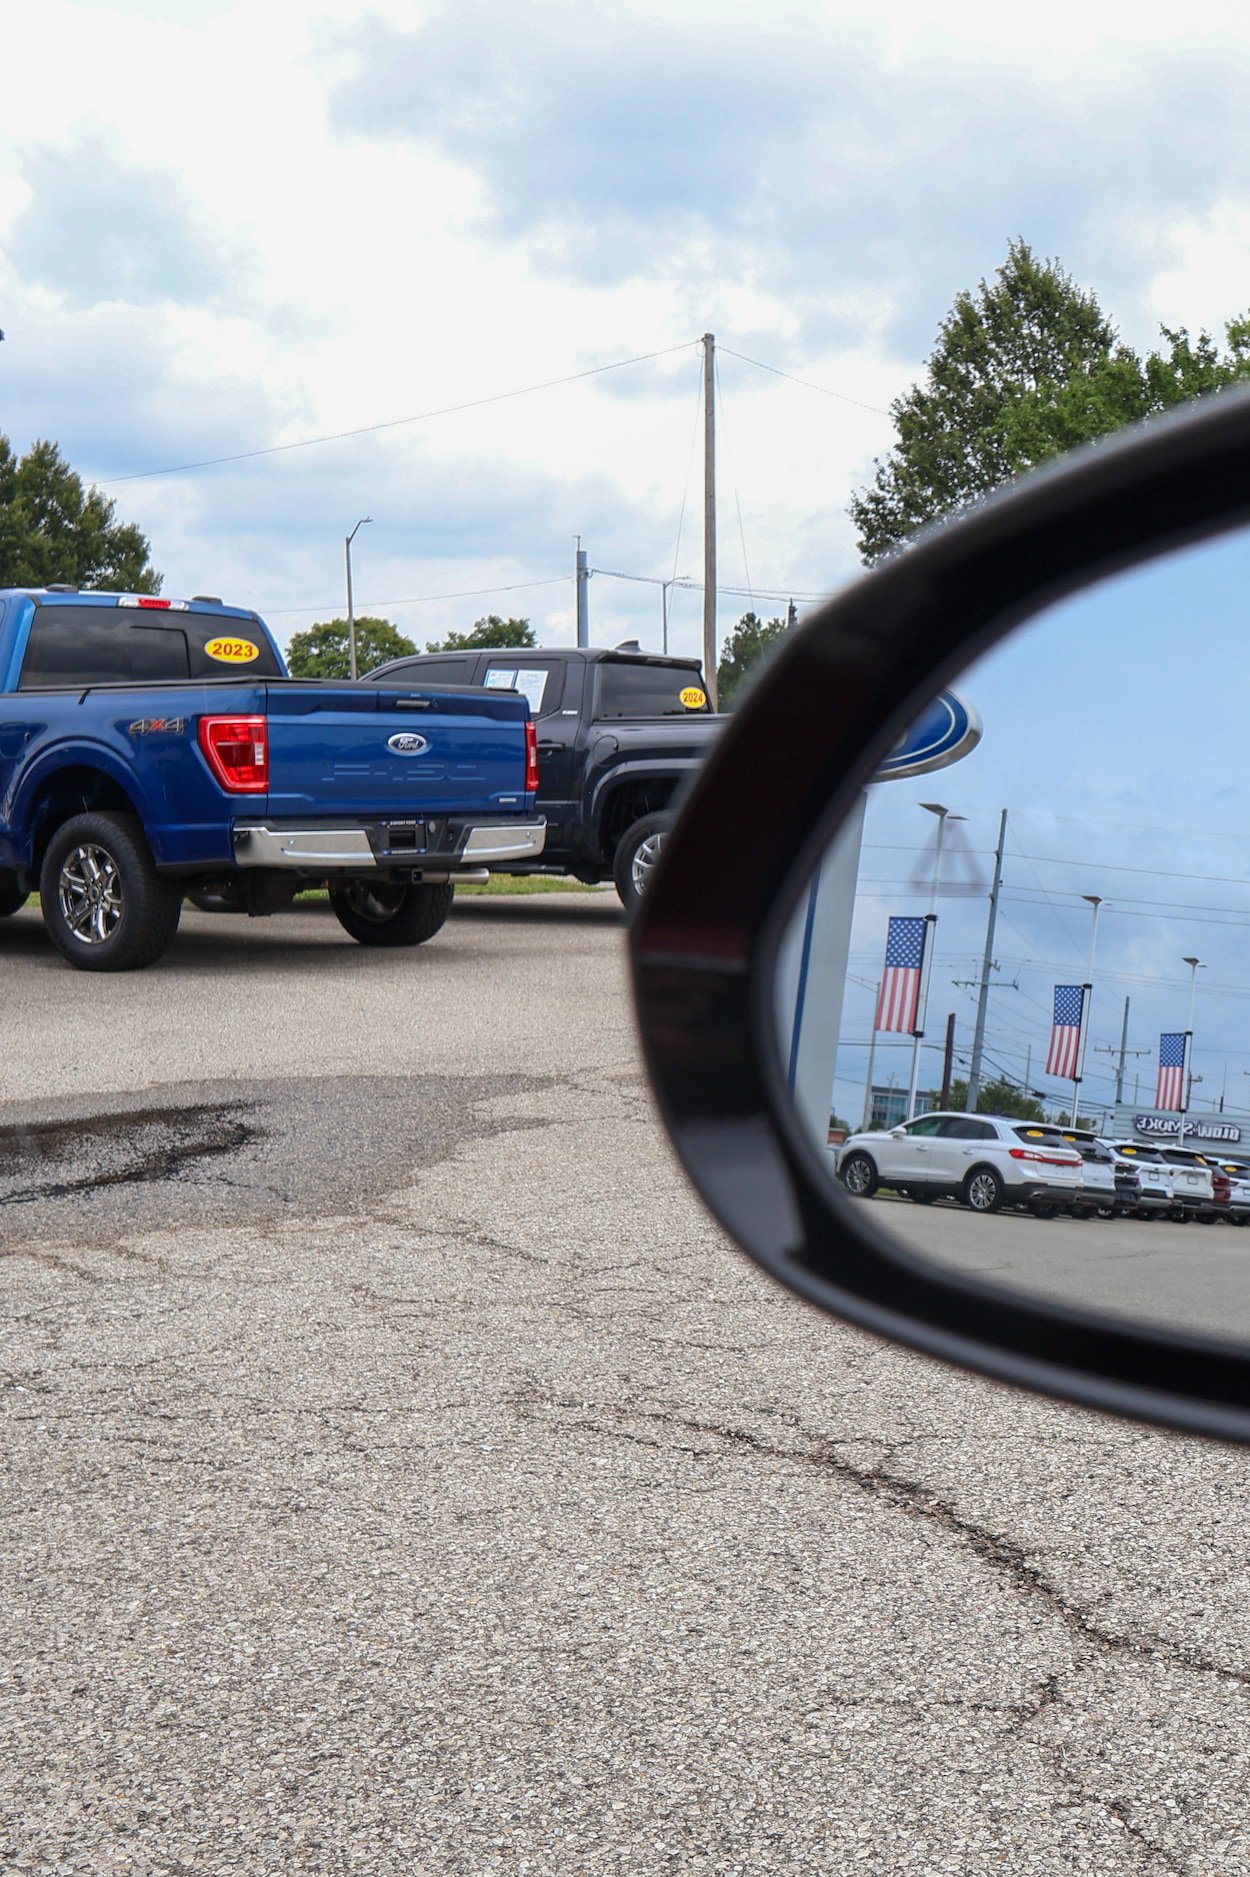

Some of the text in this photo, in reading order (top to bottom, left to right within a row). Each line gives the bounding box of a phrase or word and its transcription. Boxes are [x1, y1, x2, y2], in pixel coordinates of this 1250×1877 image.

[212, 642, 254, 658] 2023
[683, 692, 703, 703] 2024
[397, 736, 420, 750] Ford
